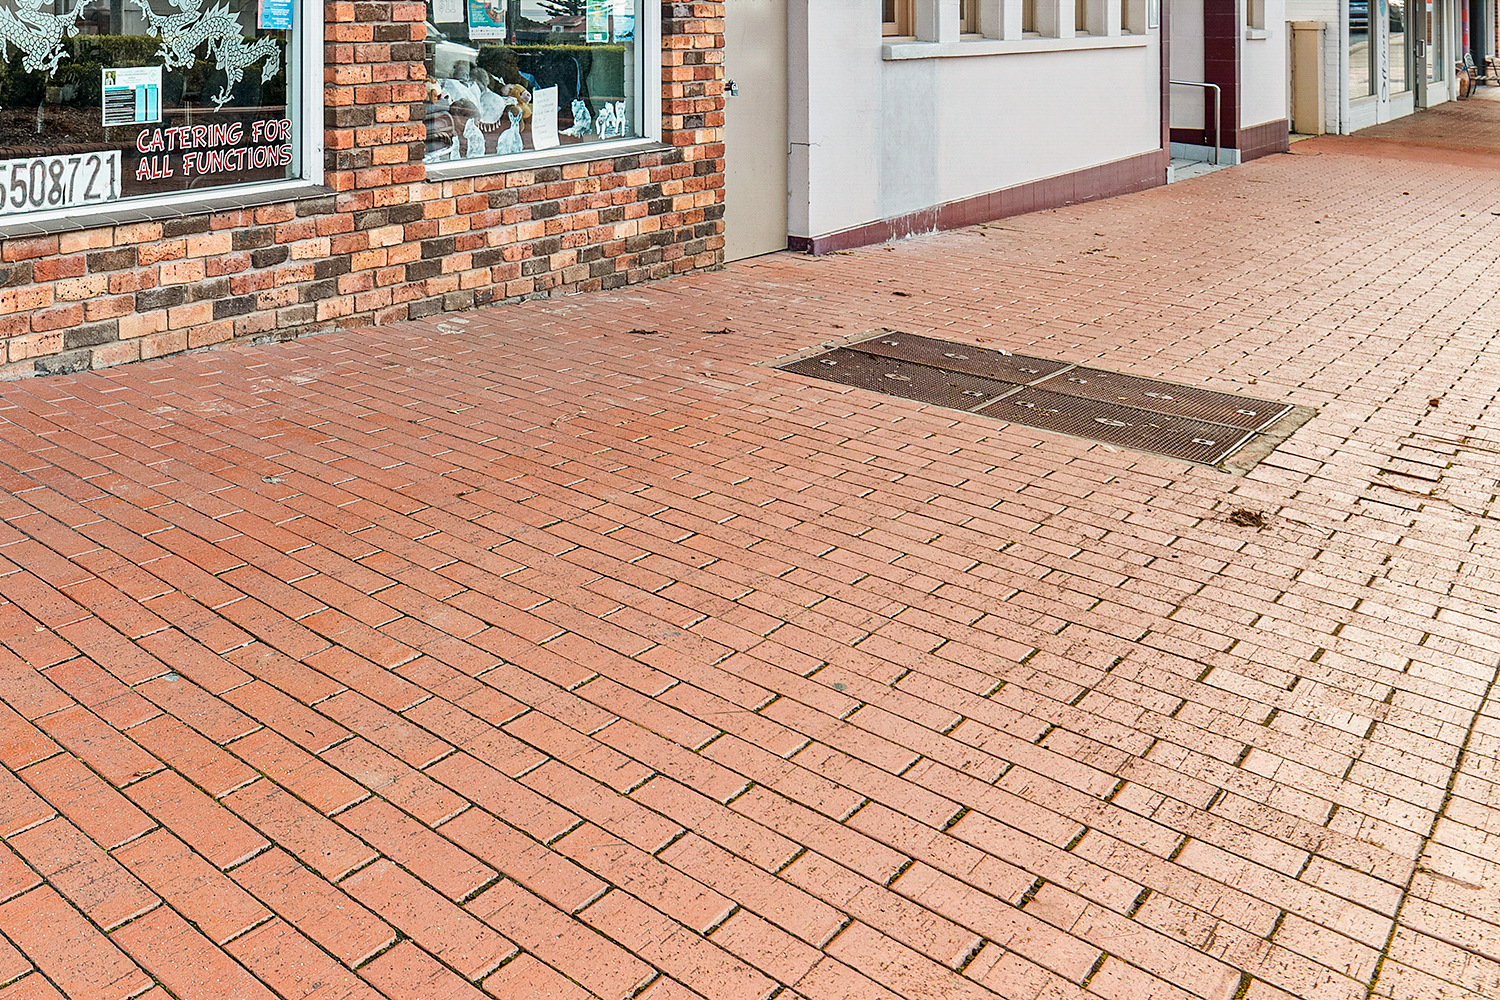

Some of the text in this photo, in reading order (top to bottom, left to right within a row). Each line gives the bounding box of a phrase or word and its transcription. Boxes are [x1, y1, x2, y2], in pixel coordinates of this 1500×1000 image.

[137, 119, 292, 153] CATERING FOR
[136, 144, 293, 181] ALL FUNCTIONS
